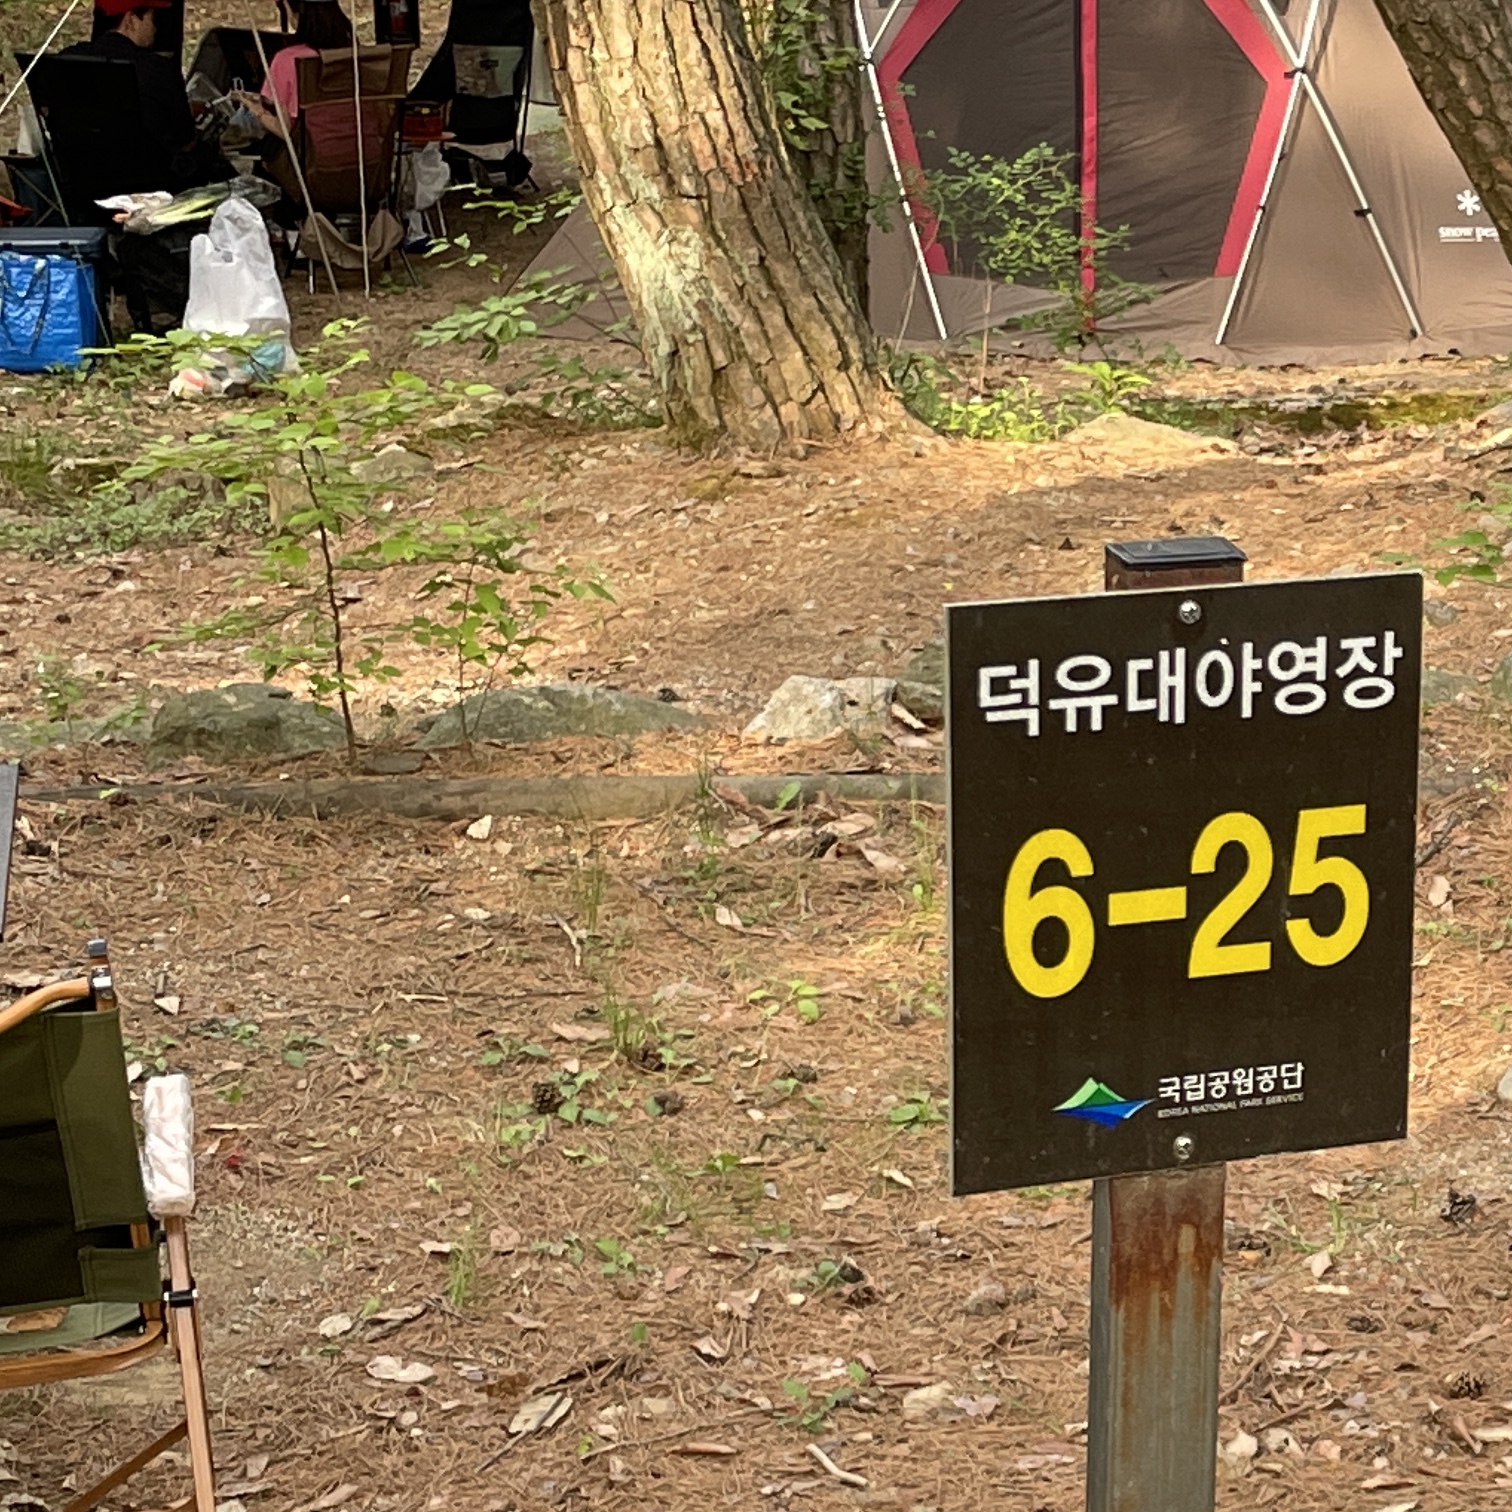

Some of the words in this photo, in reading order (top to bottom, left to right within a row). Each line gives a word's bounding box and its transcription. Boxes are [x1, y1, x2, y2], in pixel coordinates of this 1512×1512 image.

[1438, 226, 1475, 238] snow
[976, 629, 1404, 737] 덕유대야영장
[1003, 803, 1370, 998] 6-25
[1157, 1061, 1306, 1104] 국립공원공단
